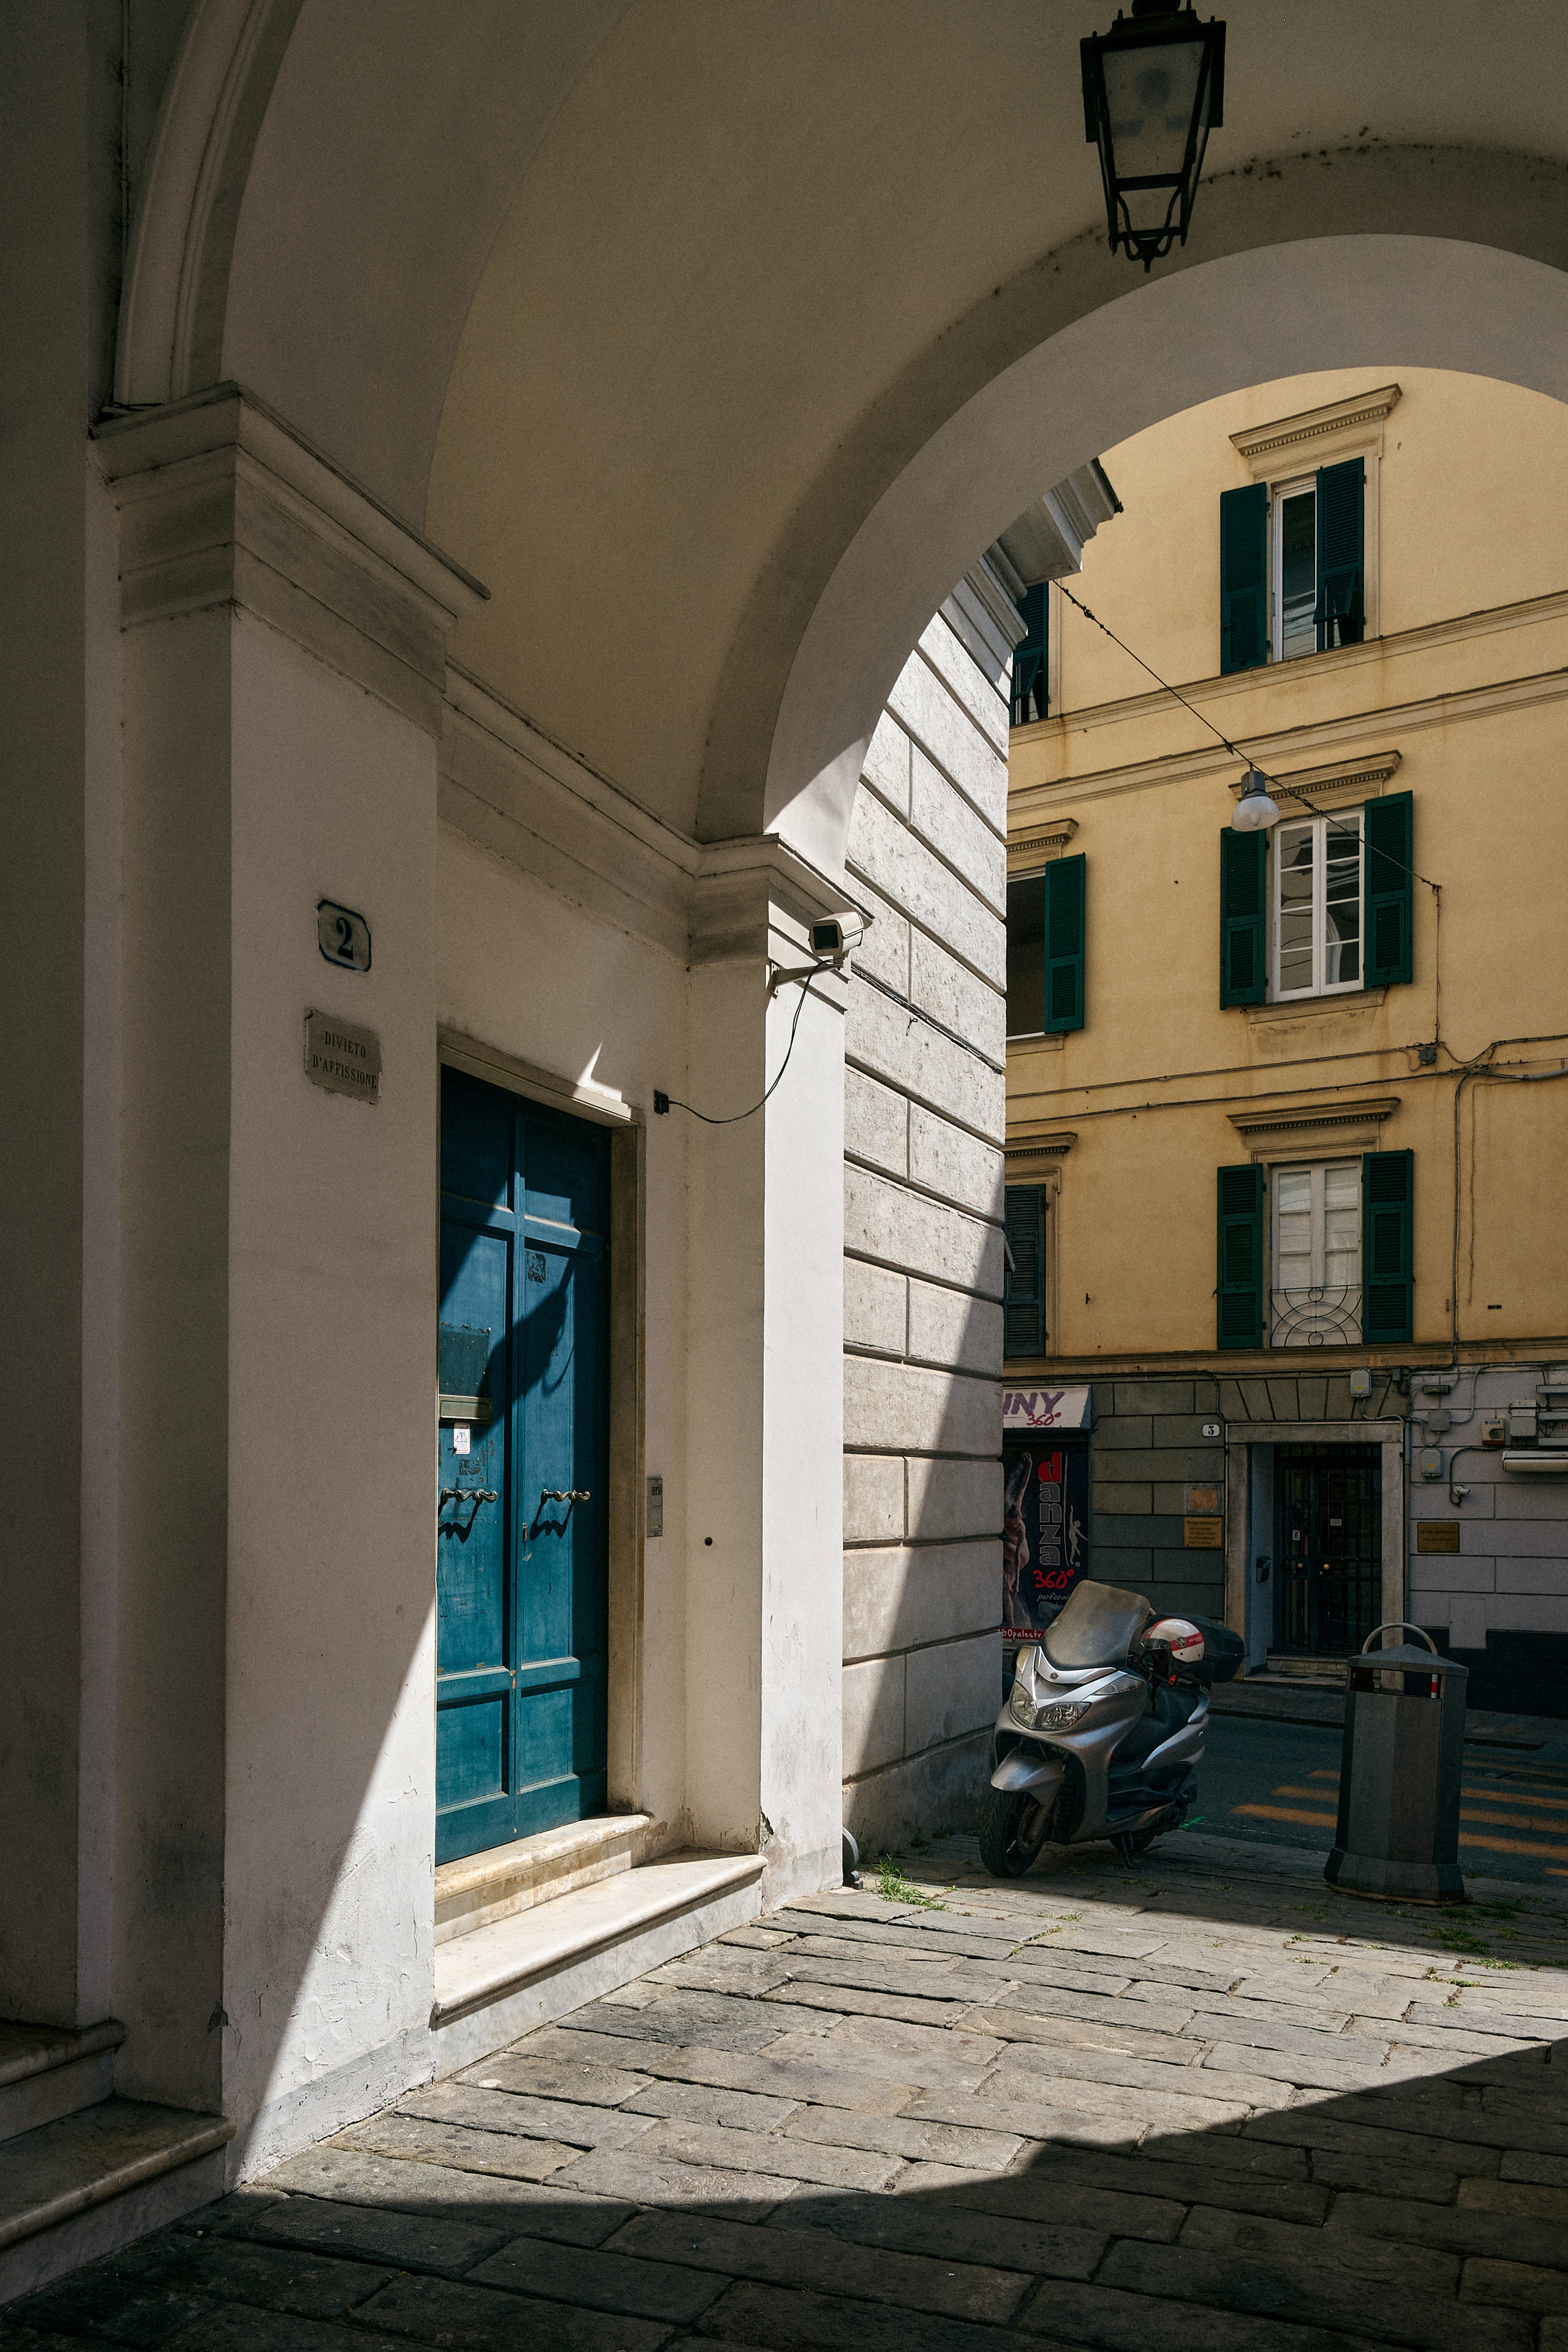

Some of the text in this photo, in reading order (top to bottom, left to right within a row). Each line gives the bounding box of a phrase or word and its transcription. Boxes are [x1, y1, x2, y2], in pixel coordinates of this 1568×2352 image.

[336, 917, 354, 961] 2
[323, 1031, 366, 1058] DIVIETO
[312, 1054, 377, 1088] D'AFFISSIONE
[1208, 1425, 1215, 1435] 3
[1038, 1452, 1061, 1566] danza
